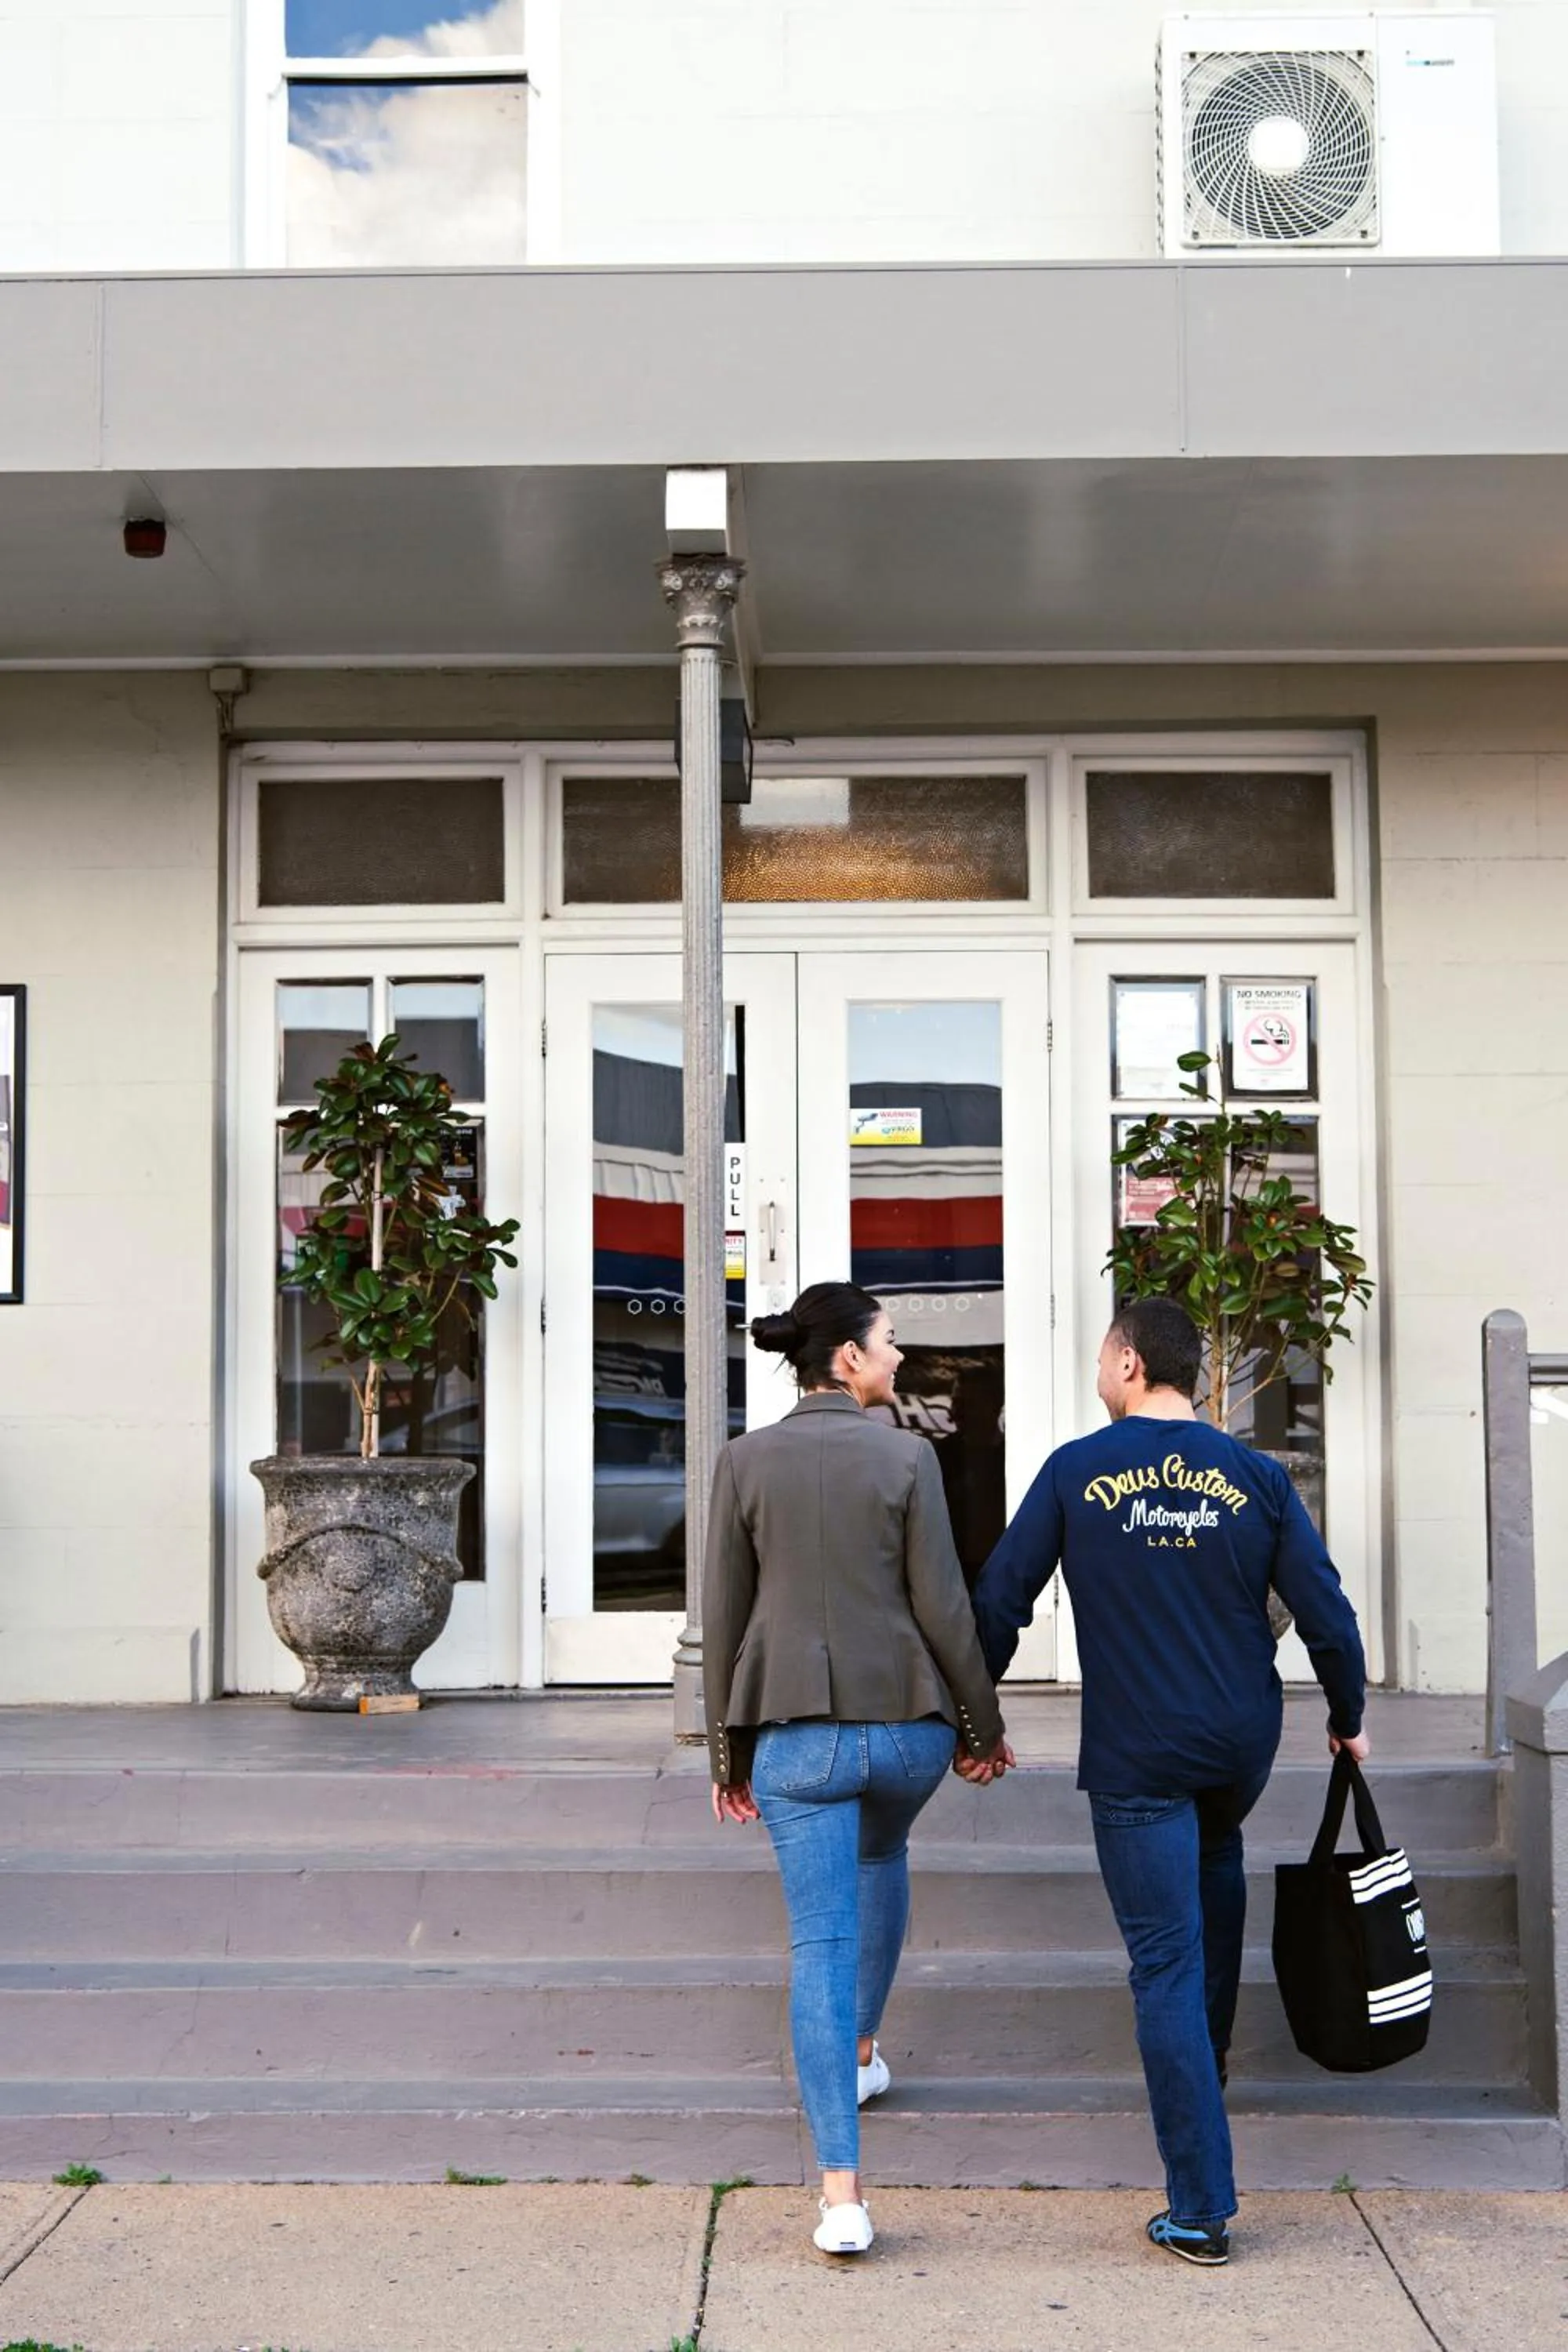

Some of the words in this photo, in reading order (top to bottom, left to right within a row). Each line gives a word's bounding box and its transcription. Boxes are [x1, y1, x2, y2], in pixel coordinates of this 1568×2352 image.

[730, 1156, 741, 1217] PULL
[1084, 1466, 1160, 1511] Deus
[1162, 1454, 1248, 1515] Custom
[1123, 1498, 1219, 1537] Motorcycles
